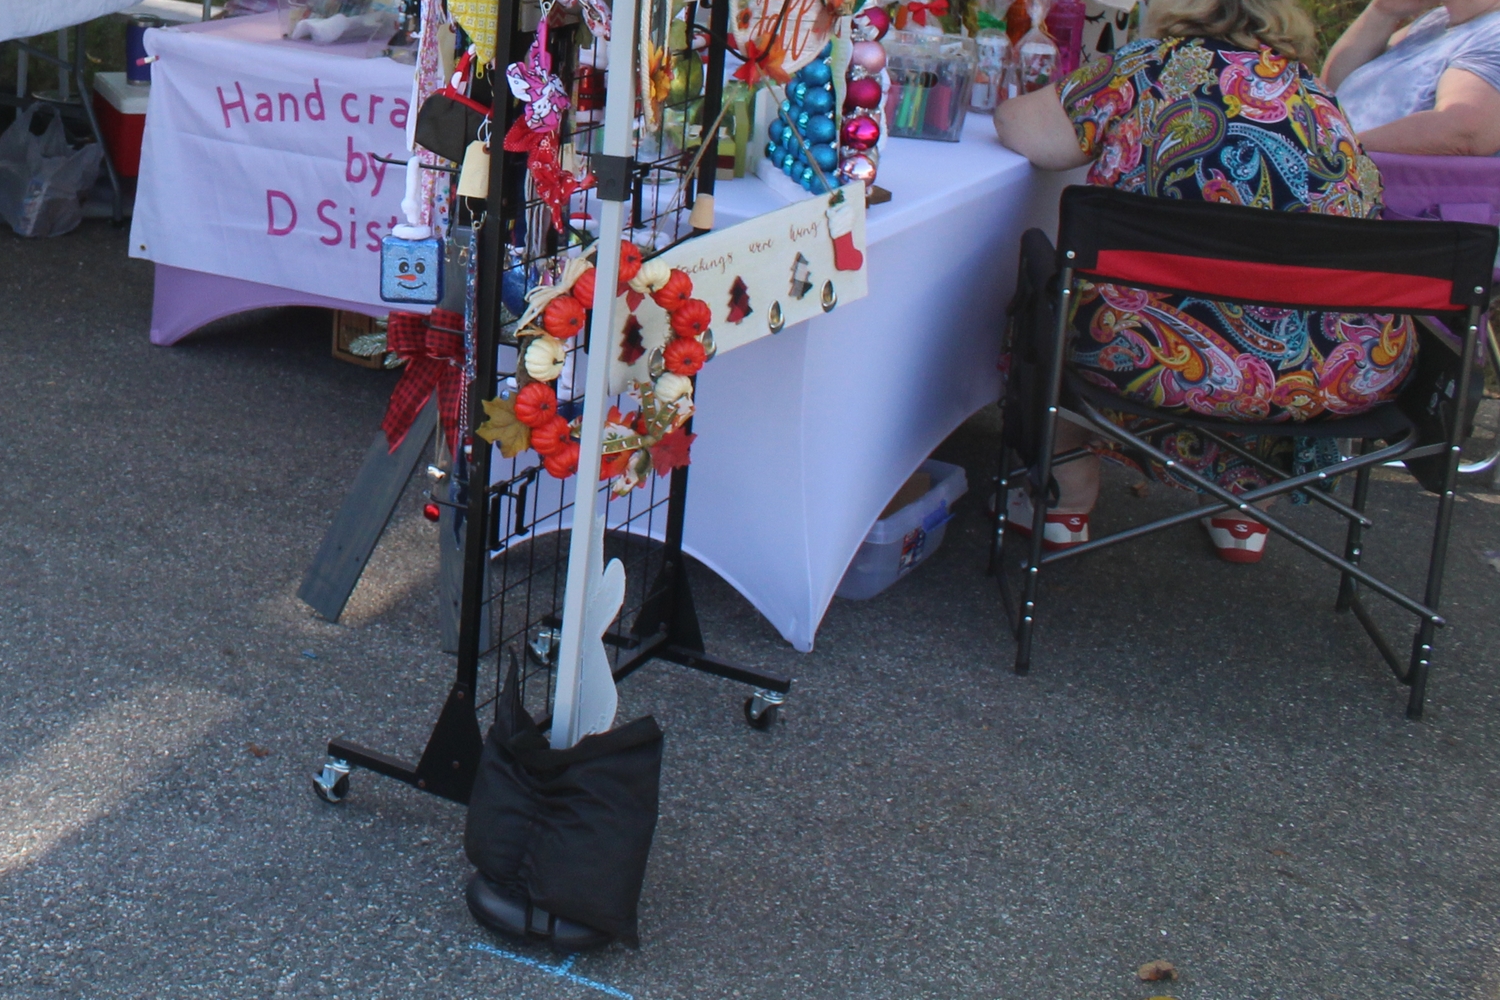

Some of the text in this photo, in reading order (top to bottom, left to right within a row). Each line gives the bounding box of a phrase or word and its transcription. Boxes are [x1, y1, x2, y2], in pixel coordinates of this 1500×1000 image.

[216, 78, 410, 130] Hand cra
[345, 135, 394, 198] by
[266, 188, 298, 236] D
[675, 251, 734, 275] ockings
[789, 220, 821, 242] hung
